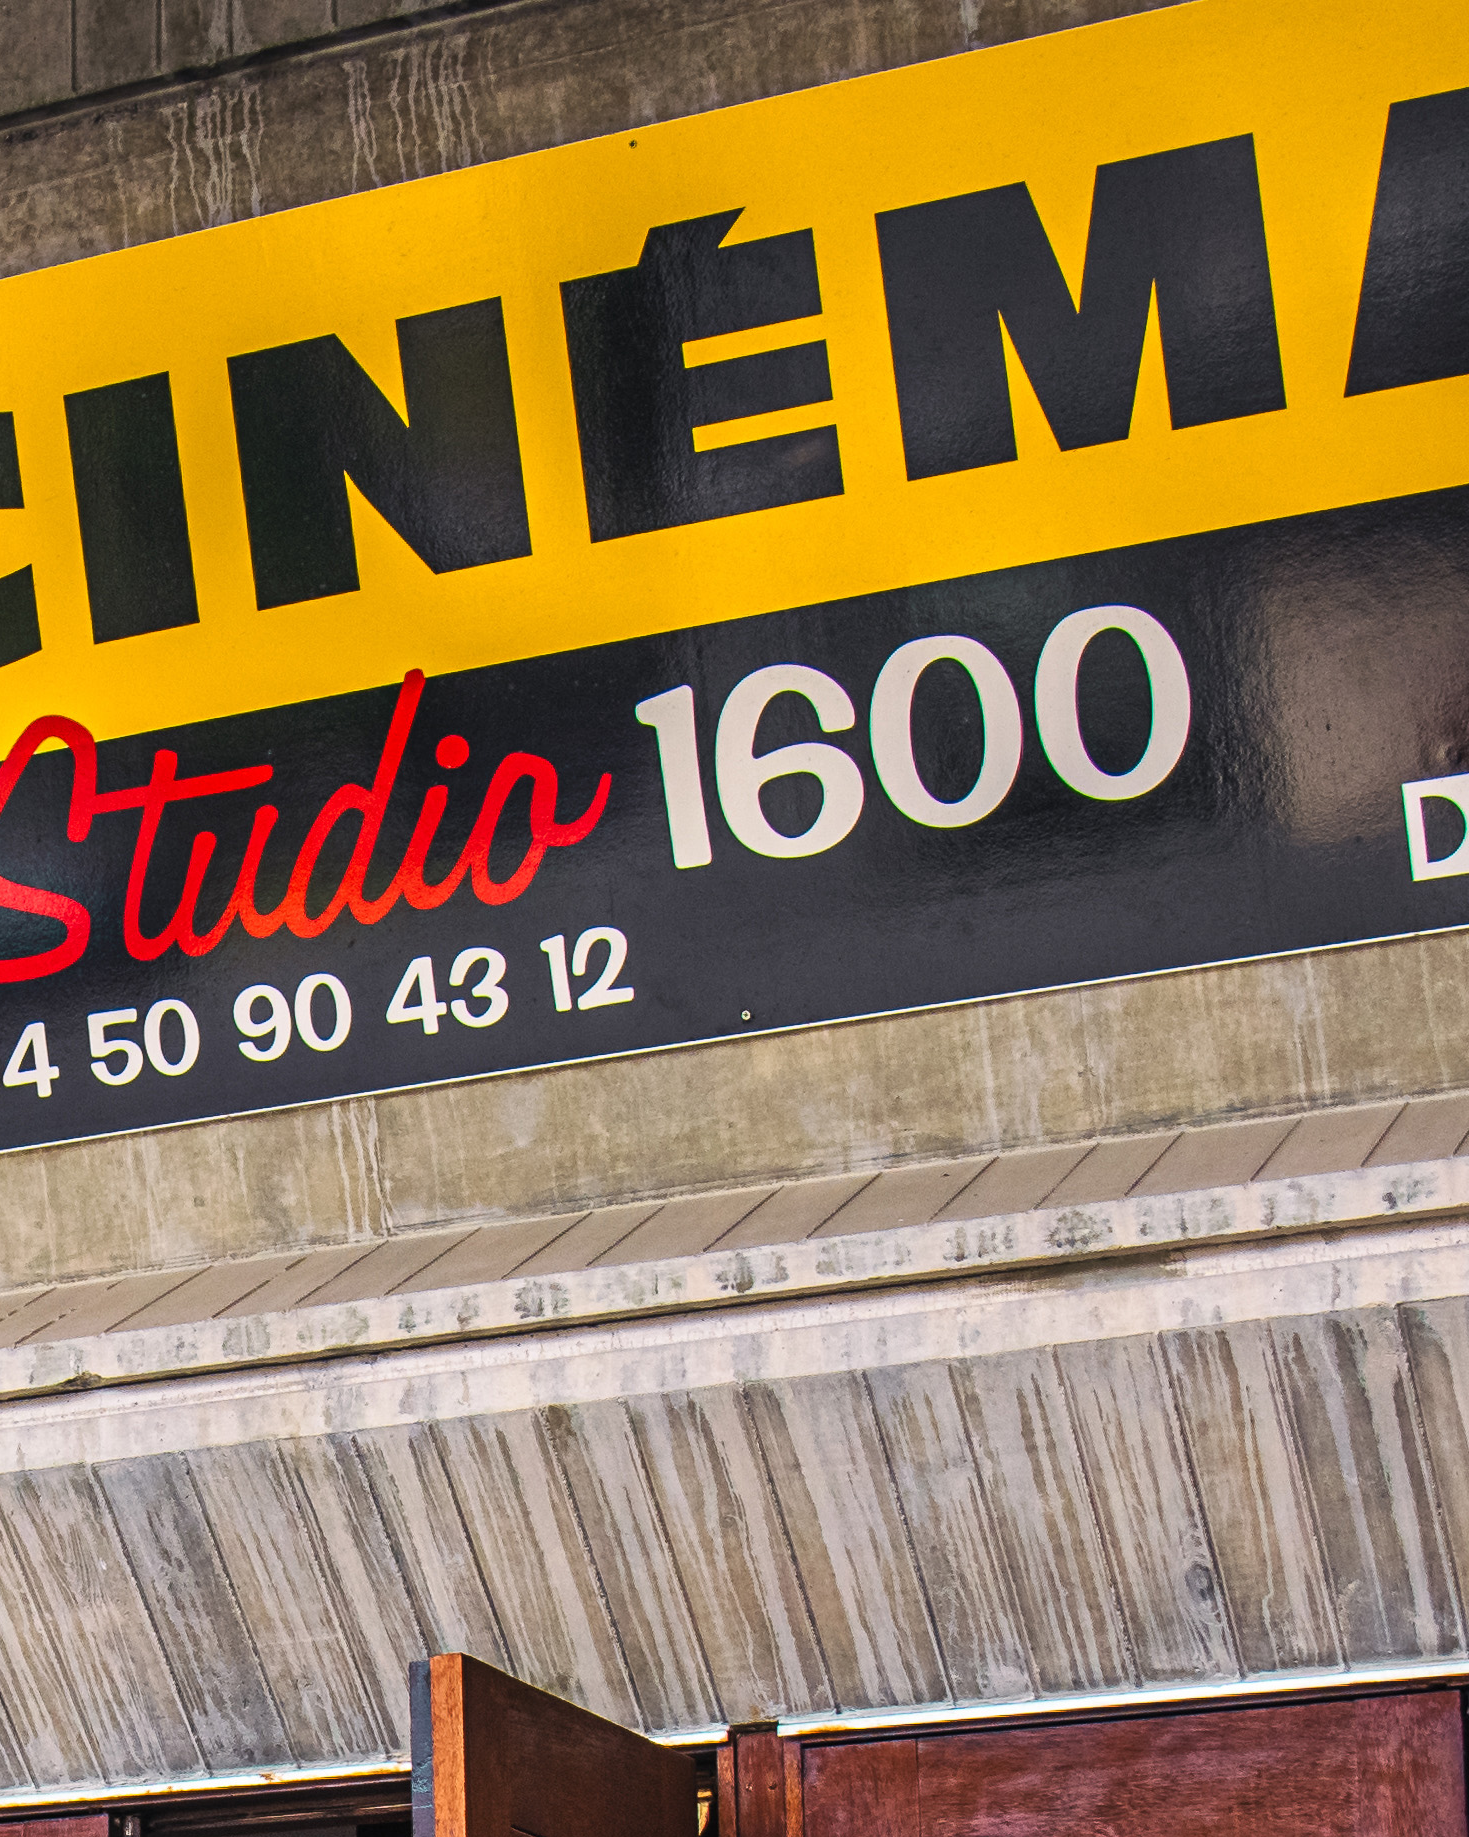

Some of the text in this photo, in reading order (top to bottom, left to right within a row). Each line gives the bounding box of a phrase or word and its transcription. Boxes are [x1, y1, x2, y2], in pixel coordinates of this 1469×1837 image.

[635, 604, 1195, 872] 1600
[87, 998, 201, 1086] 50
[233, 972, 352, 1062] 90
[386, 946, 510, 1035] 43
[541, 926, 635, 1012] 12
